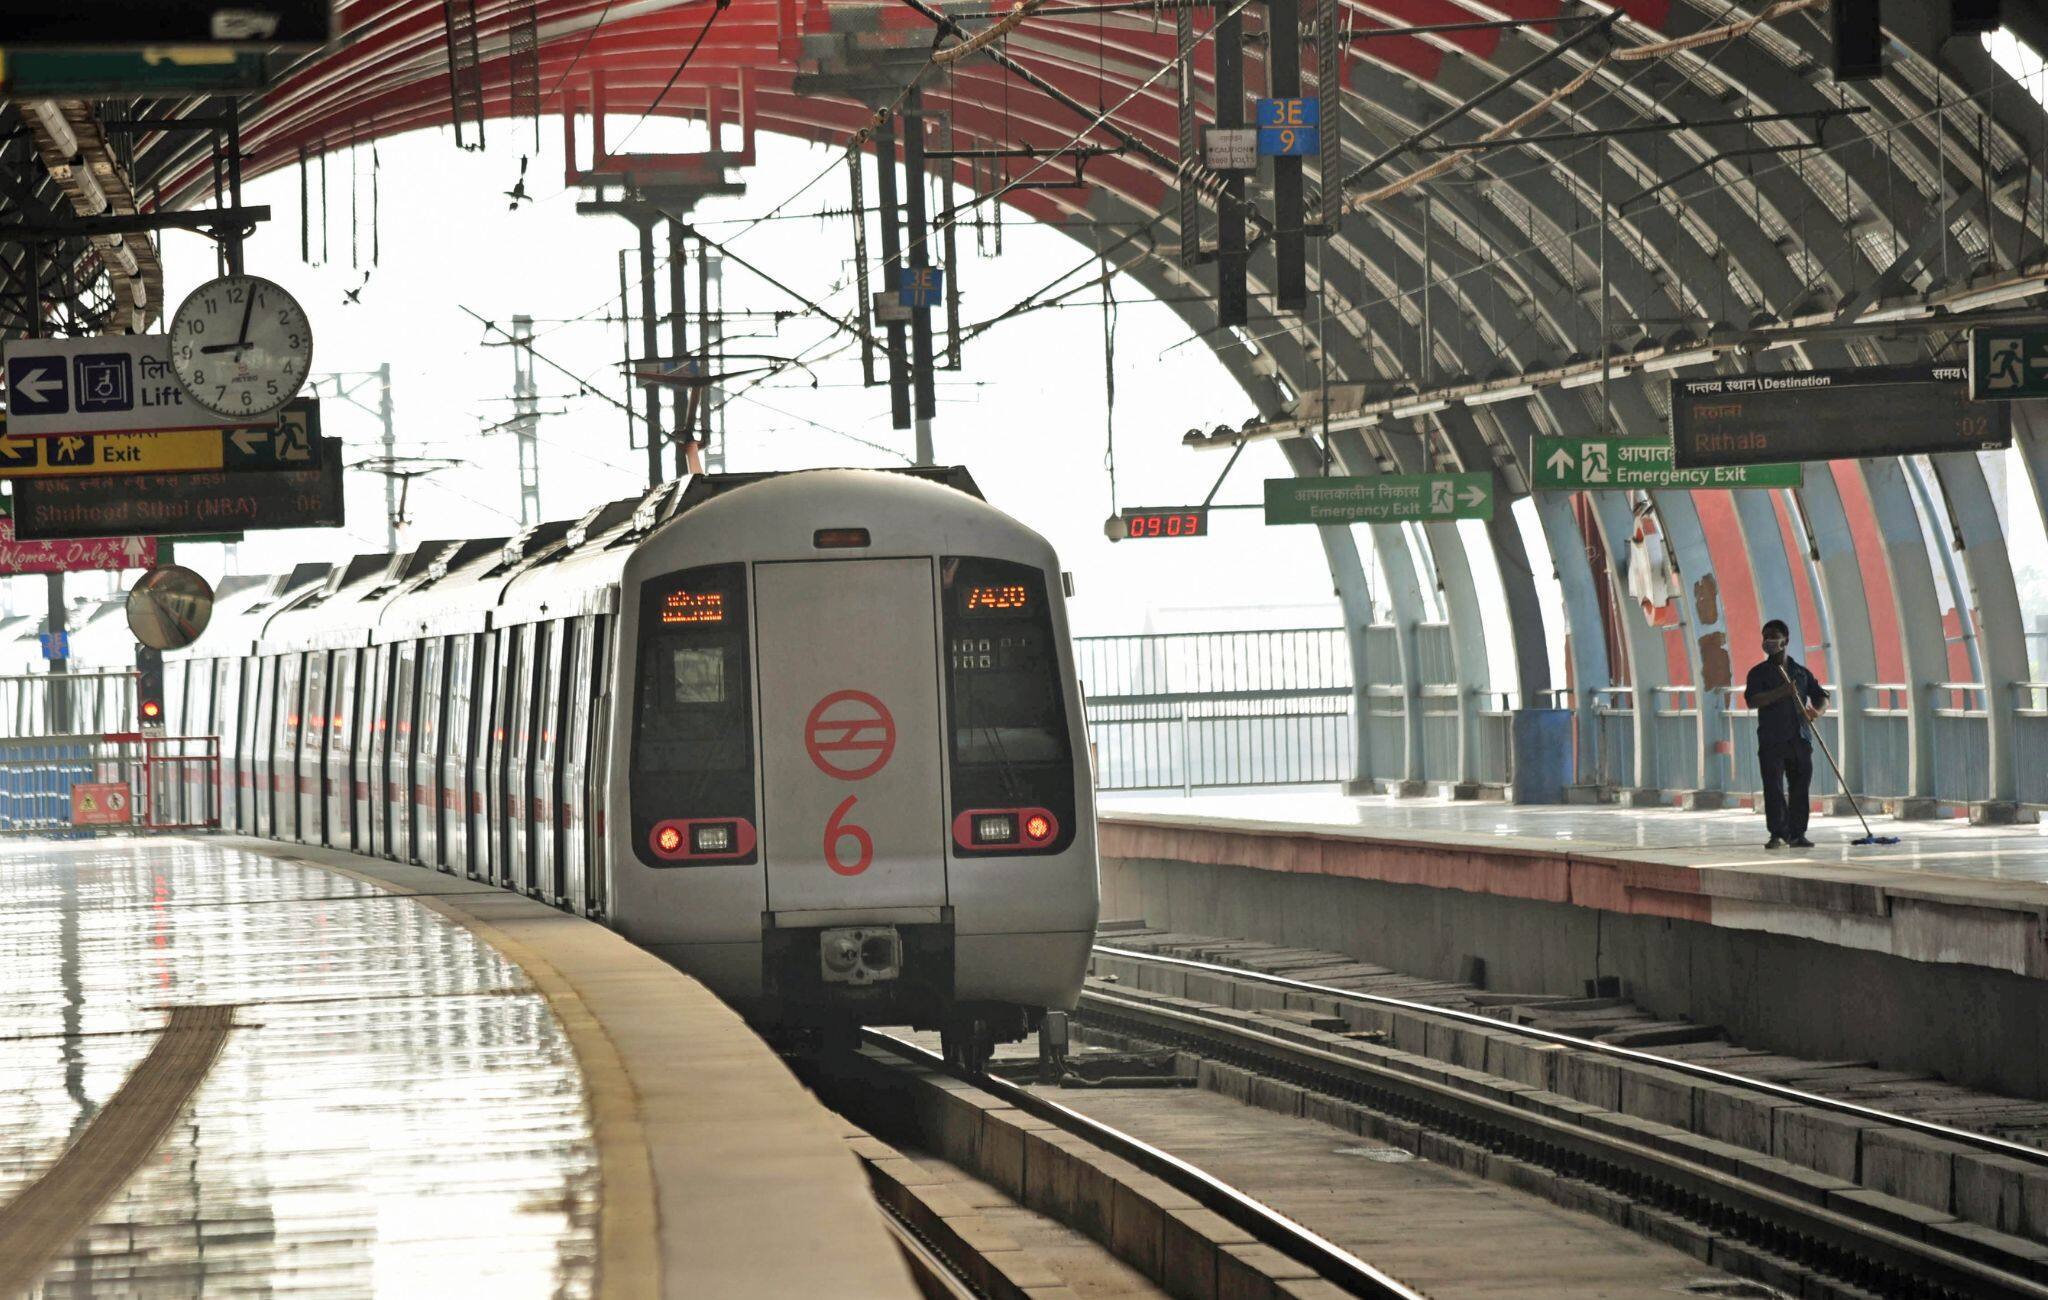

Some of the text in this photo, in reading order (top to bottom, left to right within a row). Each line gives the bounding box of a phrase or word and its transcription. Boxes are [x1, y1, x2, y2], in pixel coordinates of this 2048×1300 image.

[1273, 100, 1303, 125] 3E
[1281, 129, 1295, 155] 9
[226, 287, 244, 304] 12
[258, 294, 265, 309] 1
[205, 298, 217, 314] 11
[278, 310, 289, 325] 2
[187, 319, 205, 335] 10
[288, 334, 300, 349] 3
[181, 345, 193, 360] 9
[282, 360, 293, 375] 4
[193, 370, 205, 385] 8
[215, 385, 227, 401] 7
[266, 379, 278, 395] 5
[141, 386, 183, 406] Lift
[241, 391, 252, 406] 6
[1695, 431, 1768, 451] Rithala
[103, 445, 141, 462] Exit
[1616, 465, 1746, 486] Emergency Exit
[1310, 502, 1421, 519] Emergency Exit
[0, 542, 110, 568] Women Only
[823, 794, 874, 876] 6
